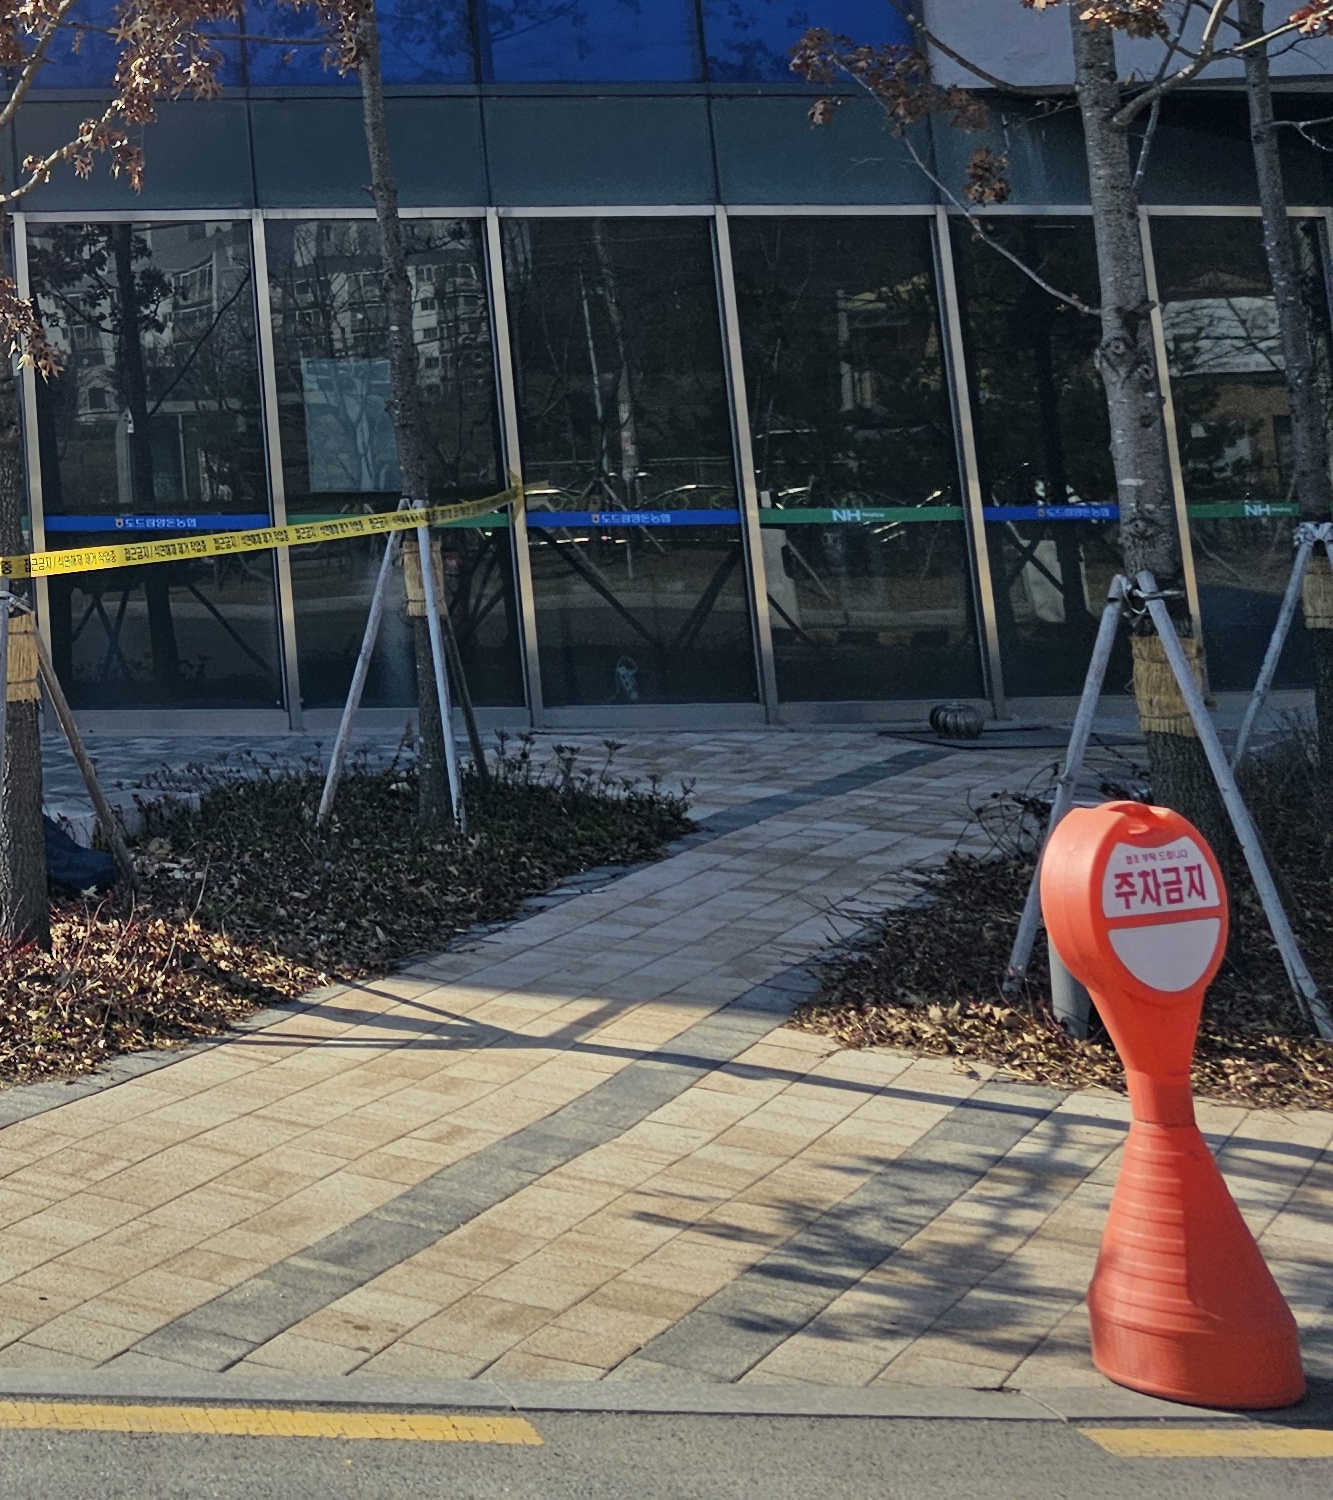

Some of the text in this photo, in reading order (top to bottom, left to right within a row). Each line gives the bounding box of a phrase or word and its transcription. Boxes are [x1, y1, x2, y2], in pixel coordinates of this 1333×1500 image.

[832, 509, 862, 521] NH
[1244, 504, 1271, 516] NH
[125, 517, 197, 528] 도드람양돈농협
[1114, 864, 1207, 910] 주차금지
